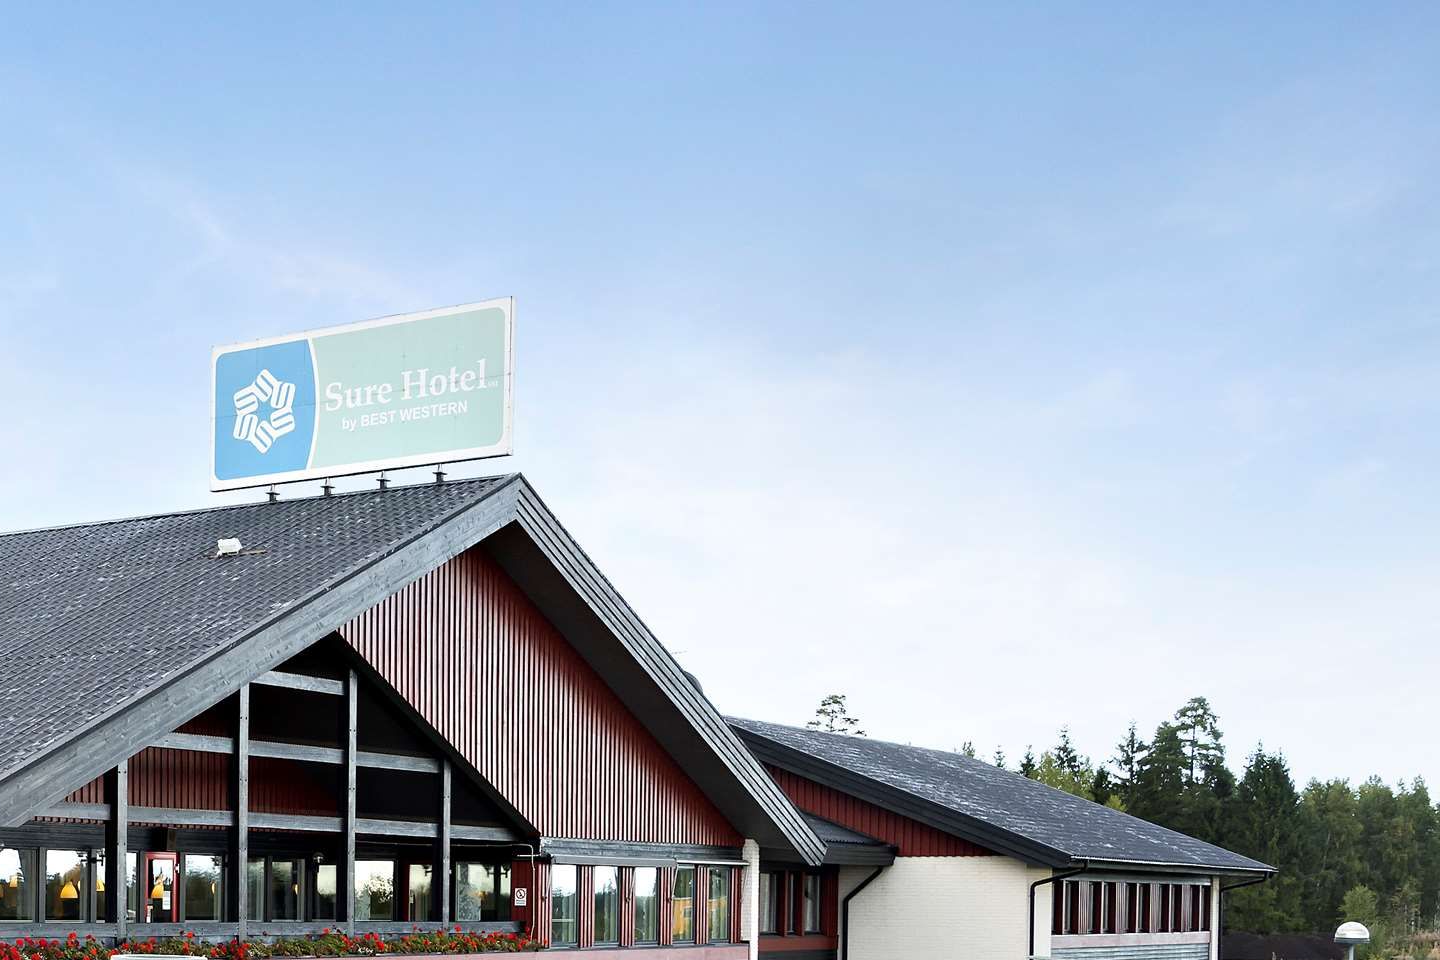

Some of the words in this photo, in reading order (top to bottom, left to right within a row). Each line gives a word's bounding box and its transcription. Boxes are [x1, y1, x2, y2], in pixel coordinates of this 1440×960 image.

[325, 382, 393, 411] Sure
[400, 358, 488, 400] Hotel
[342, 417, 357, 431] by
[361, 410, 396, 427] BEST
[400, 399, 468, 421] WESTERN
